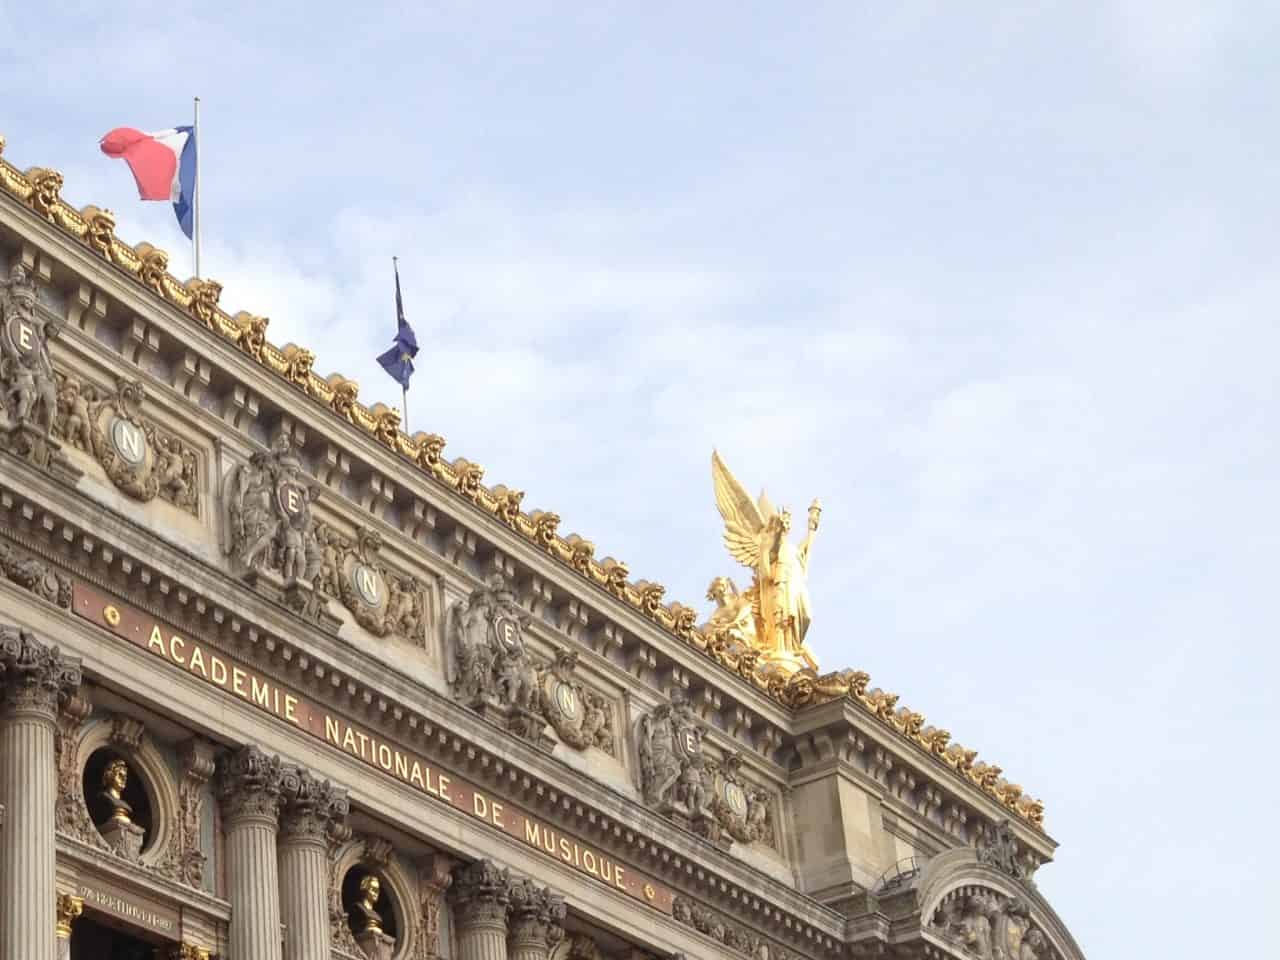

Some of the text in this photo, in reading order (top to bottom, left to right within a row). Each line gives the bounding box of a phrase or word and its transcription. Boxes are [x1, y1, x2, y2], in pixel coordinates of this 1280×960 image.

[19, 322, 33, 351] E
[121, 429, 139, 458] N
[287, 491, 299, 513] E
[363, 572, 377, 597] N
[504, 623, 515, 644] E
[148, 624, 627, 891] ACADEMIE NATIONALE DE MUSIQUE
